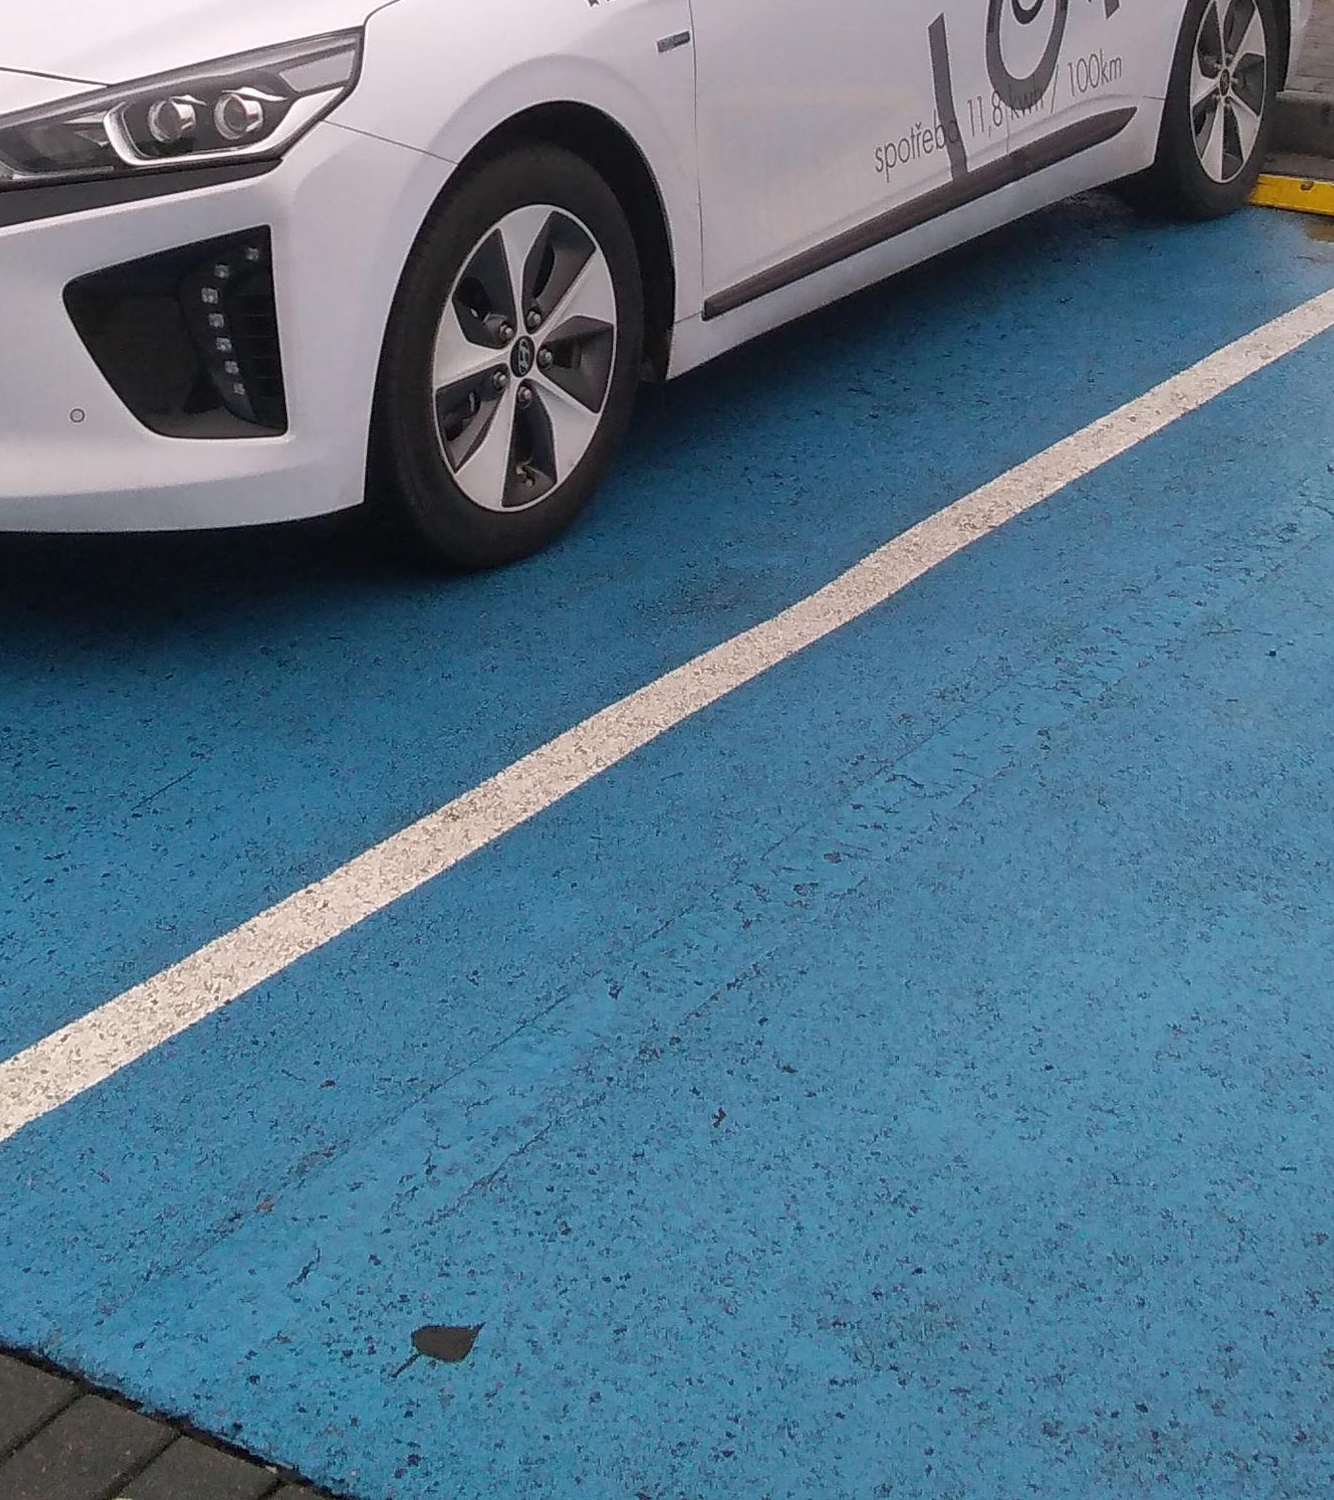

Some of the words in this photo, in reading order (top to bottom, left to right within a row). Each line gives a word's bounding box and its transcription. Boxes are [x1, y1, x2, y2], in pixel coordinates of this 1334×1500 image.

[875, 109, 960, 184] spotřeba
[967, 90, 1004, 138] 11,8
[1068, 48, 1123, 97] 100km
